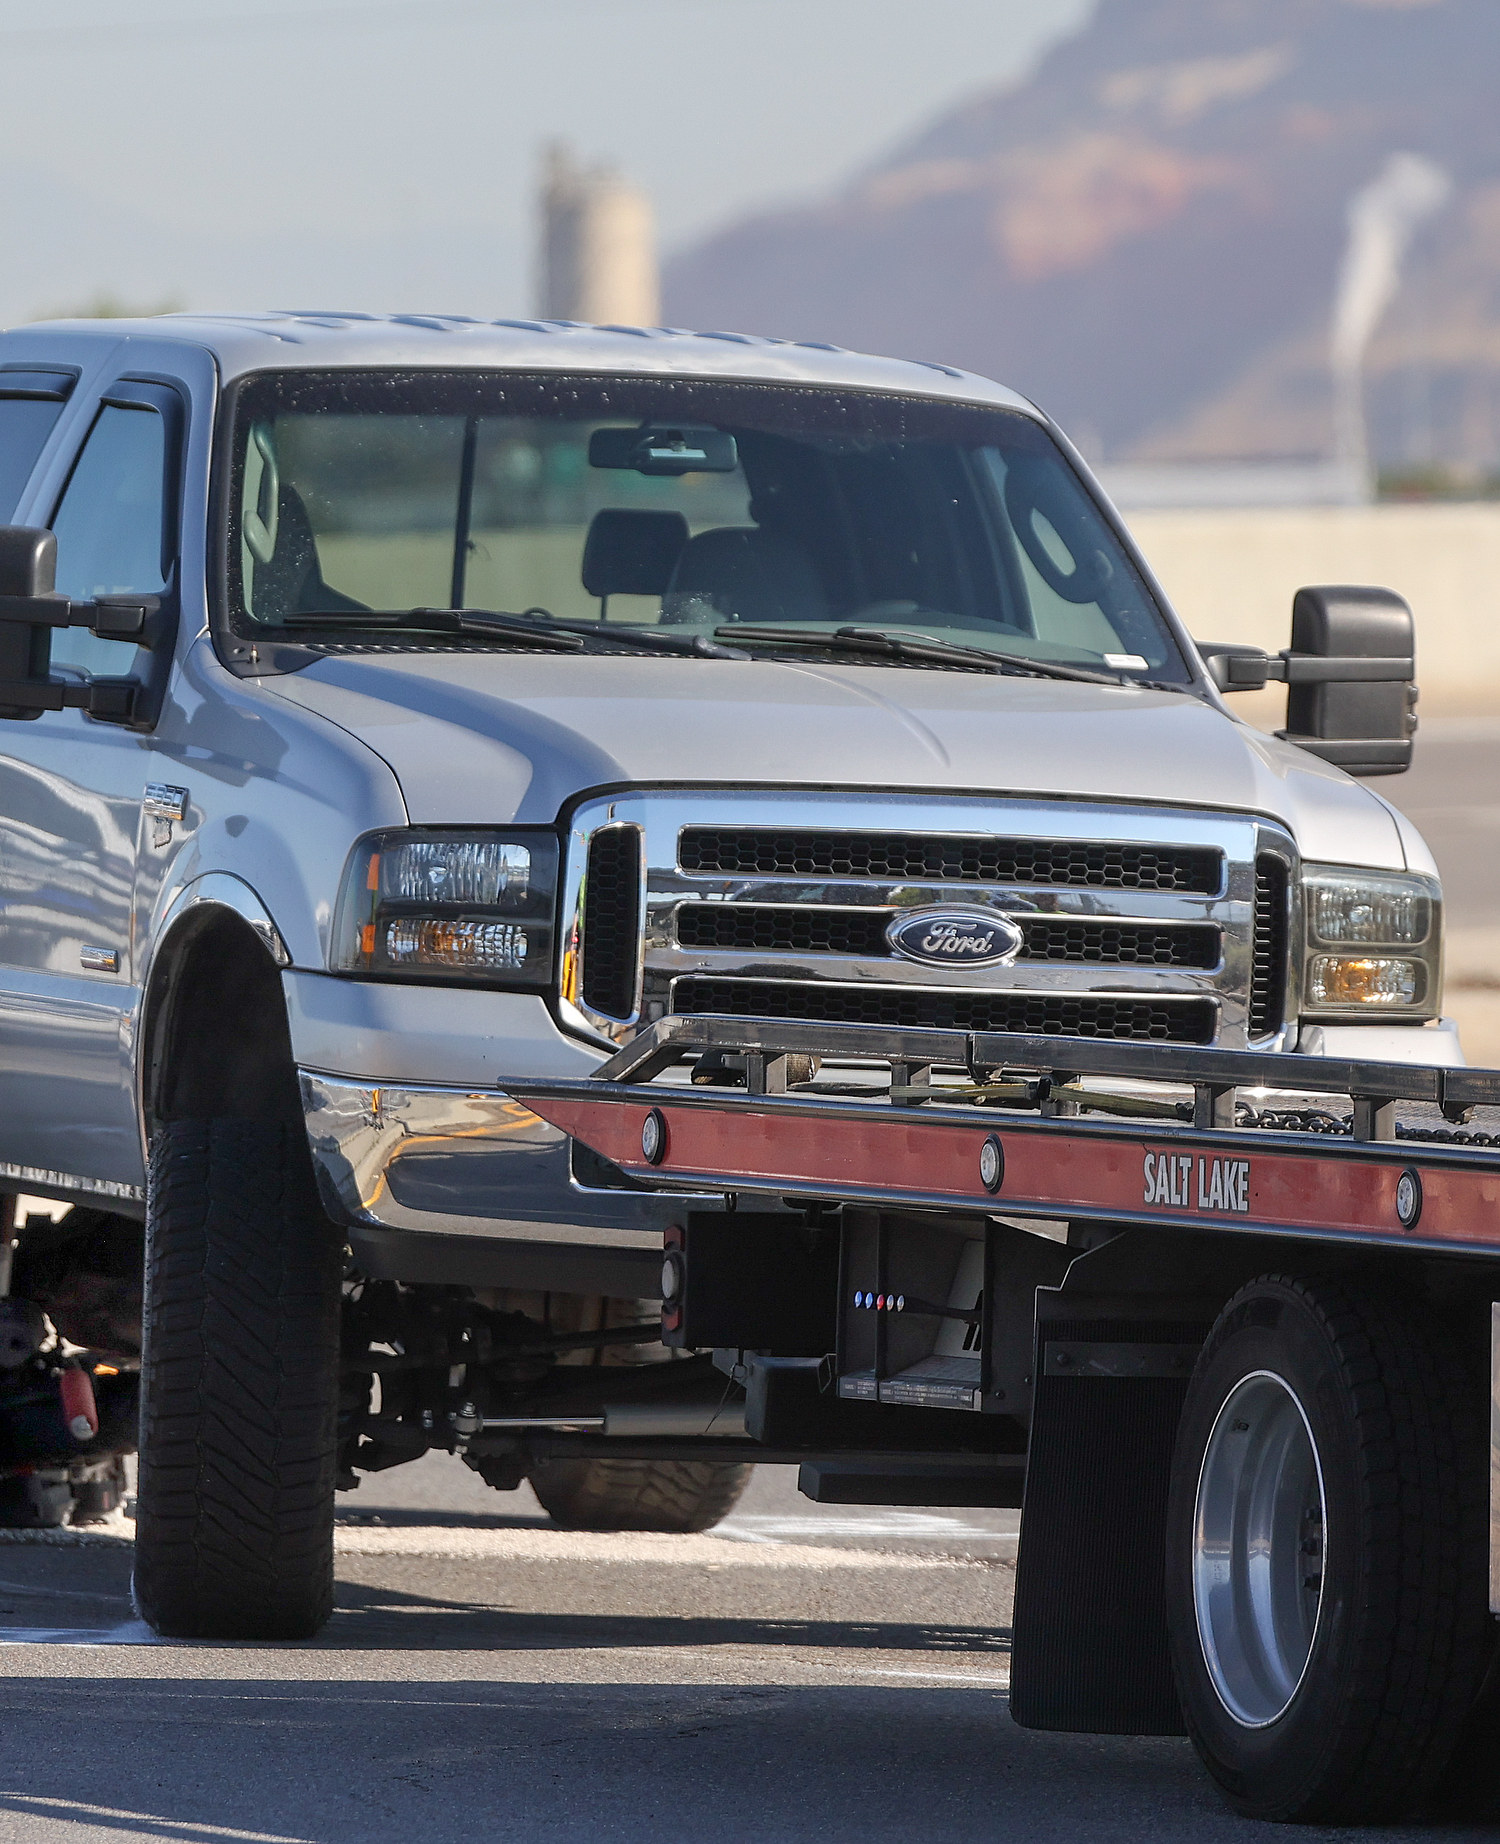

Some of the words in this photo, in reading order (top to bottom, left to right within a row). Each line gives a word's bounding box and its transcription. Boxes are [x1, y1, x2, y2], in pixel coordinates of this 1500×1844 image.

[923, 921, 994, 953] Ford
[1143, 1152, 1192, 1206] SALT
[1198, 1158, 1249, 1212] LAKE
